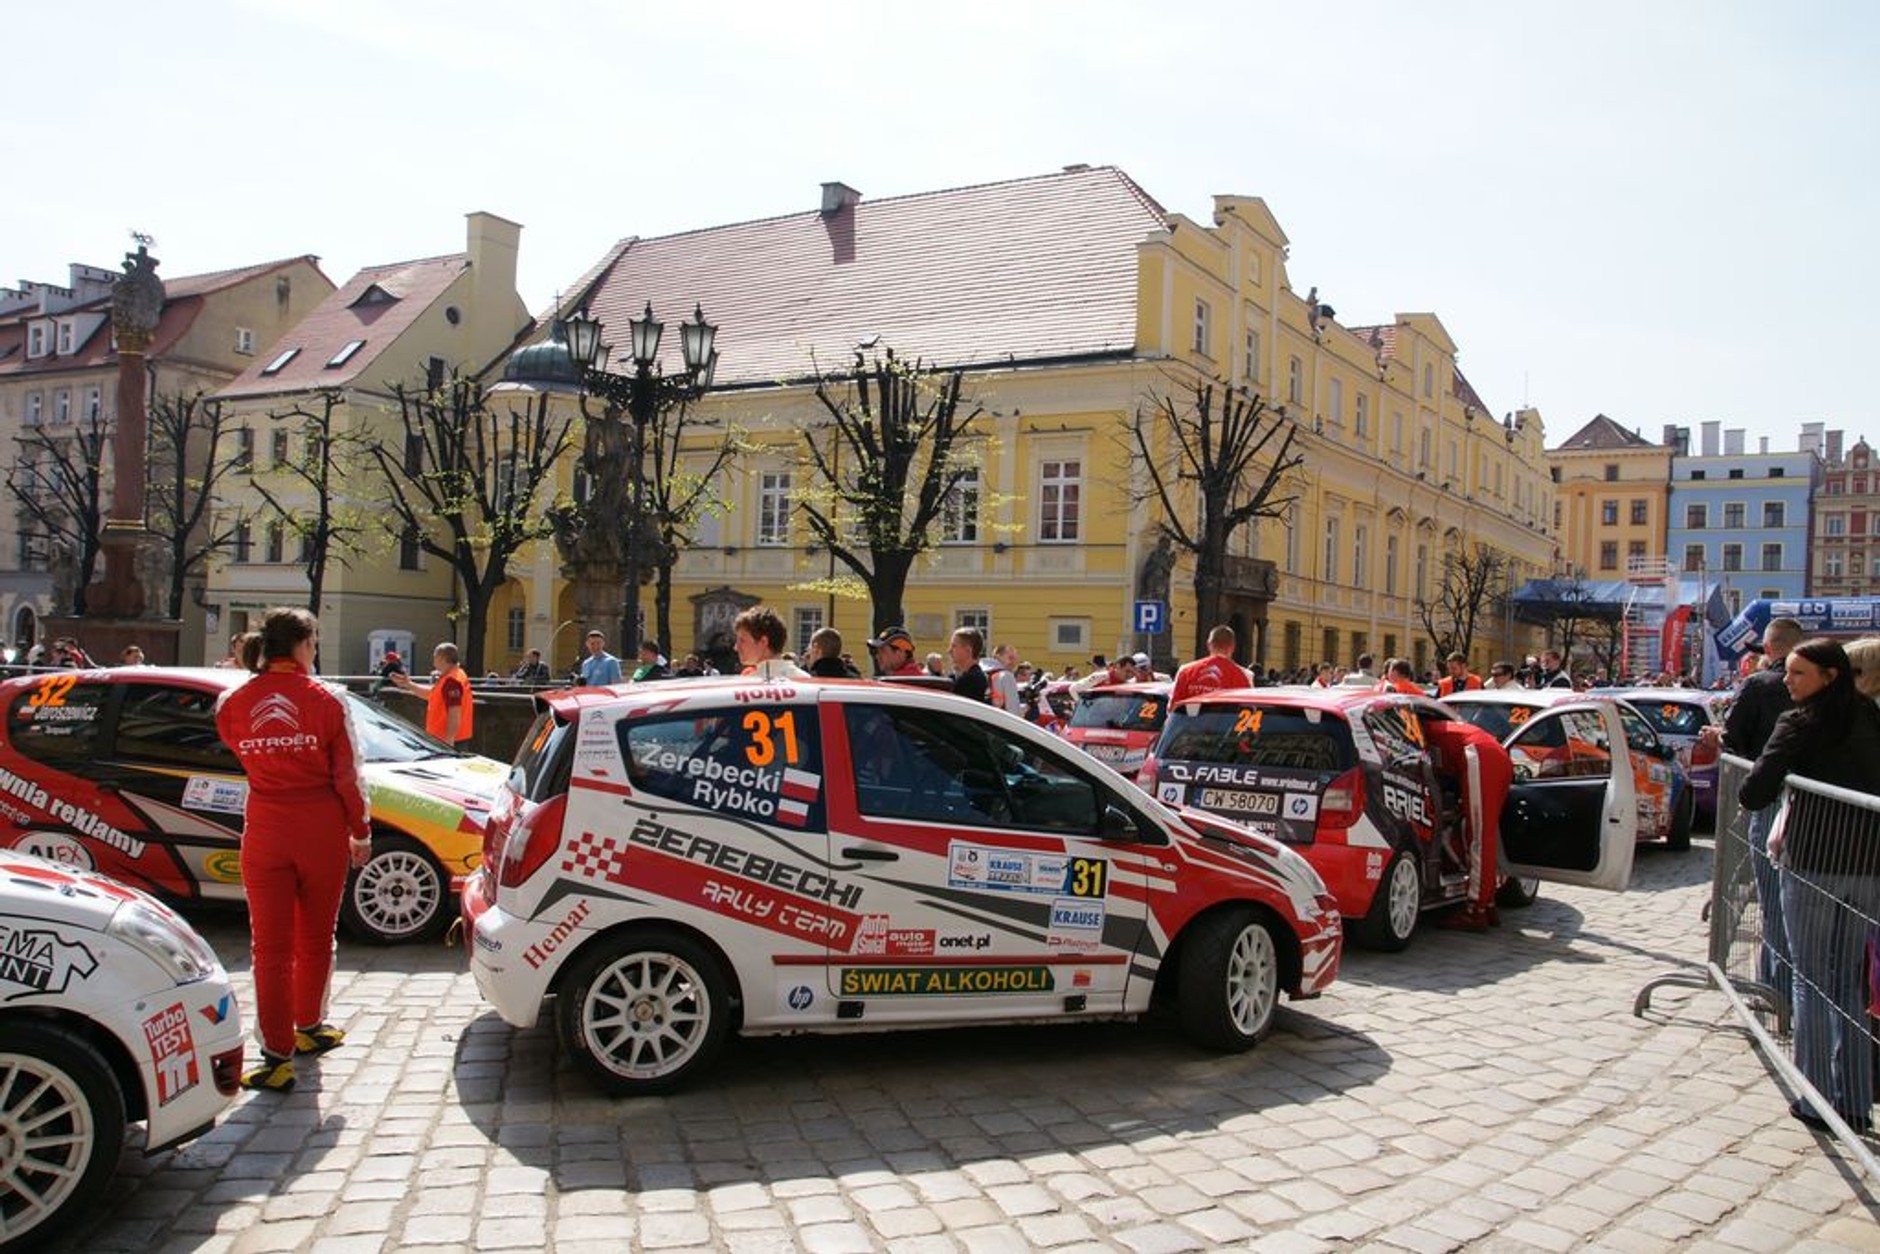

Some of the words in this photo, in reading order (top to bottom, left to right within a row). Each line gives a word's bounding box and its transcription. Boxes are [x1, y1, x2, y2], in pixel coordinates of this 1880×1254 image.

[1140, 605, 1157, 629] P
[29, 676, 76, 706] 32
[1139, 703, 1158, 718] 22
[1234, 709, 1261, 732] 24
[1509, 707, 1530, 723] 23
[743, 711, 798, 766] 31
[641, 738, 782, 793] Żerebecki
[693, 779, 775, 816] Rybko
[1203, 789, 1225, 807] CW
[1228, 794, 1276, 812] 58070
[1384, 785, 1432, 827] ARIEL
[49, 798, 146, 859] reklamy
[1072, 859, 1101, 896] 31
[702, 880, 774, 917] RALLY
[778, 904, 846, 939] TEAM
[1054, 911, 1100, 925] KRAUSE
[522, 899, 590, 970] Hemar
[889, 931, 925, 942] auto
[939, 933, 990, 950] onet.pl
[844, 969, 921, 993] ŚWIAT
[926, 967, 1048, 992] ALKOHOLI
[146, 1008, 184, 1040] Turbo
[152, 1026, 188, 1056] TEST
